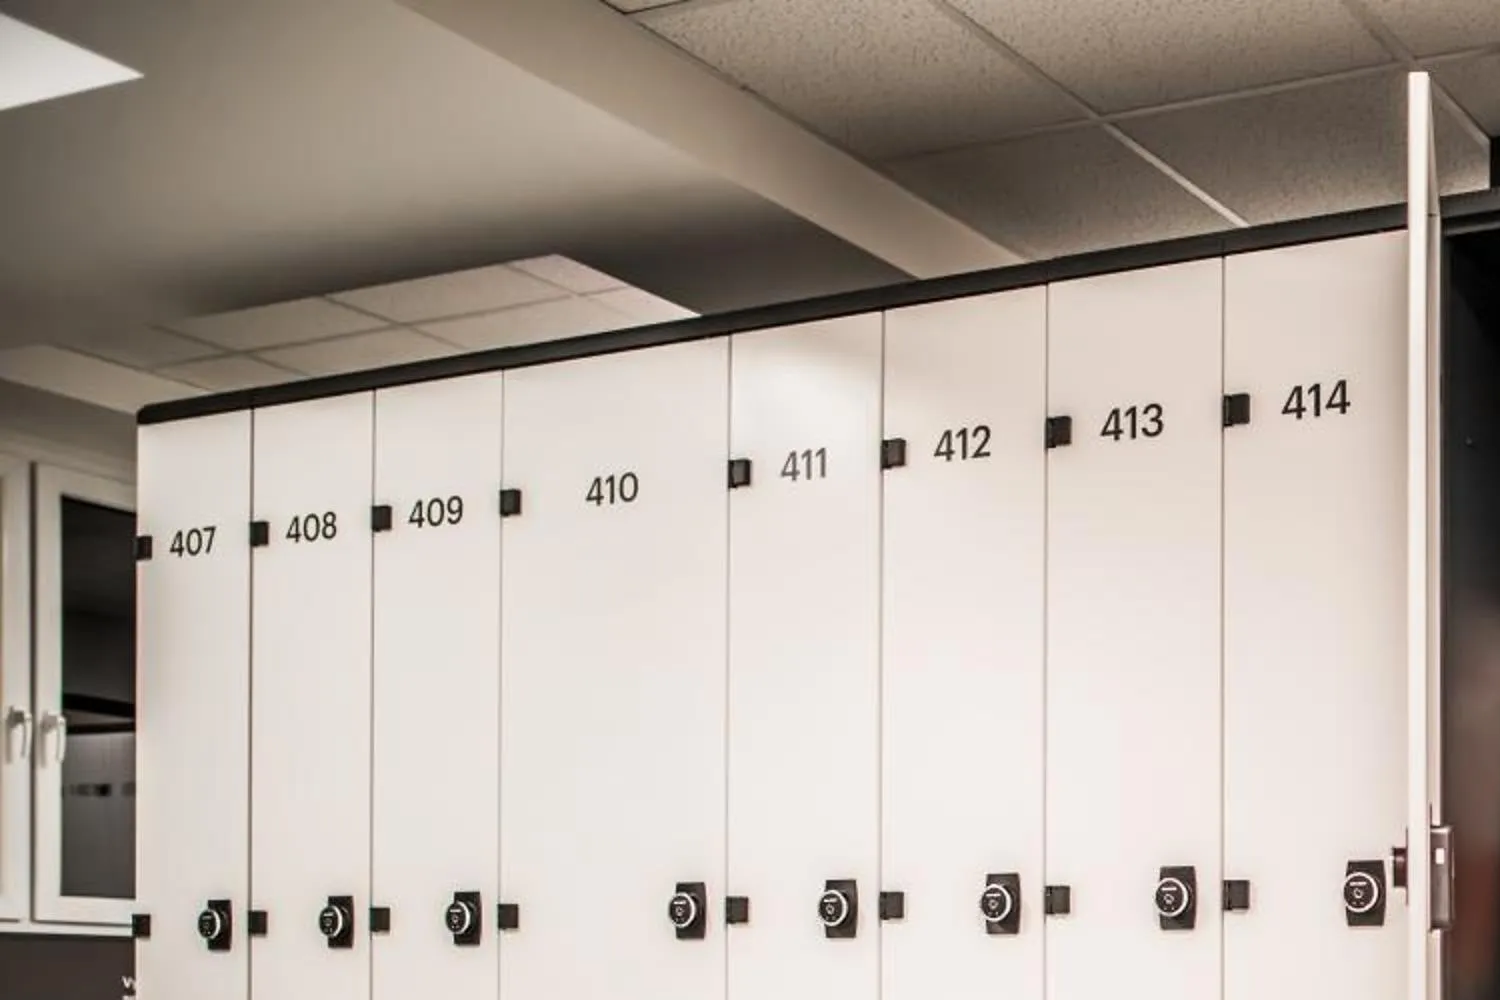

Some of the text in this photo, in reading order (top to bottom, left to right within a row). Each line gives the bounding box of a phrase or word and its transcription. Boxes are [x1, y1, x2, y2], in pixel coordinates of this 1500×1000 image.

[1281, 379, 1351, 420] 414
[1099, 402, 1164, 442] 413
[933, 424, 992, 462] 412
[780, 447, 827, 482] 411
[585, 471, 639, 507] 410
[285, 511, 337, 544] 408
[407, 495, 464, 529] 409
[169, 525, 217, 558] 407
